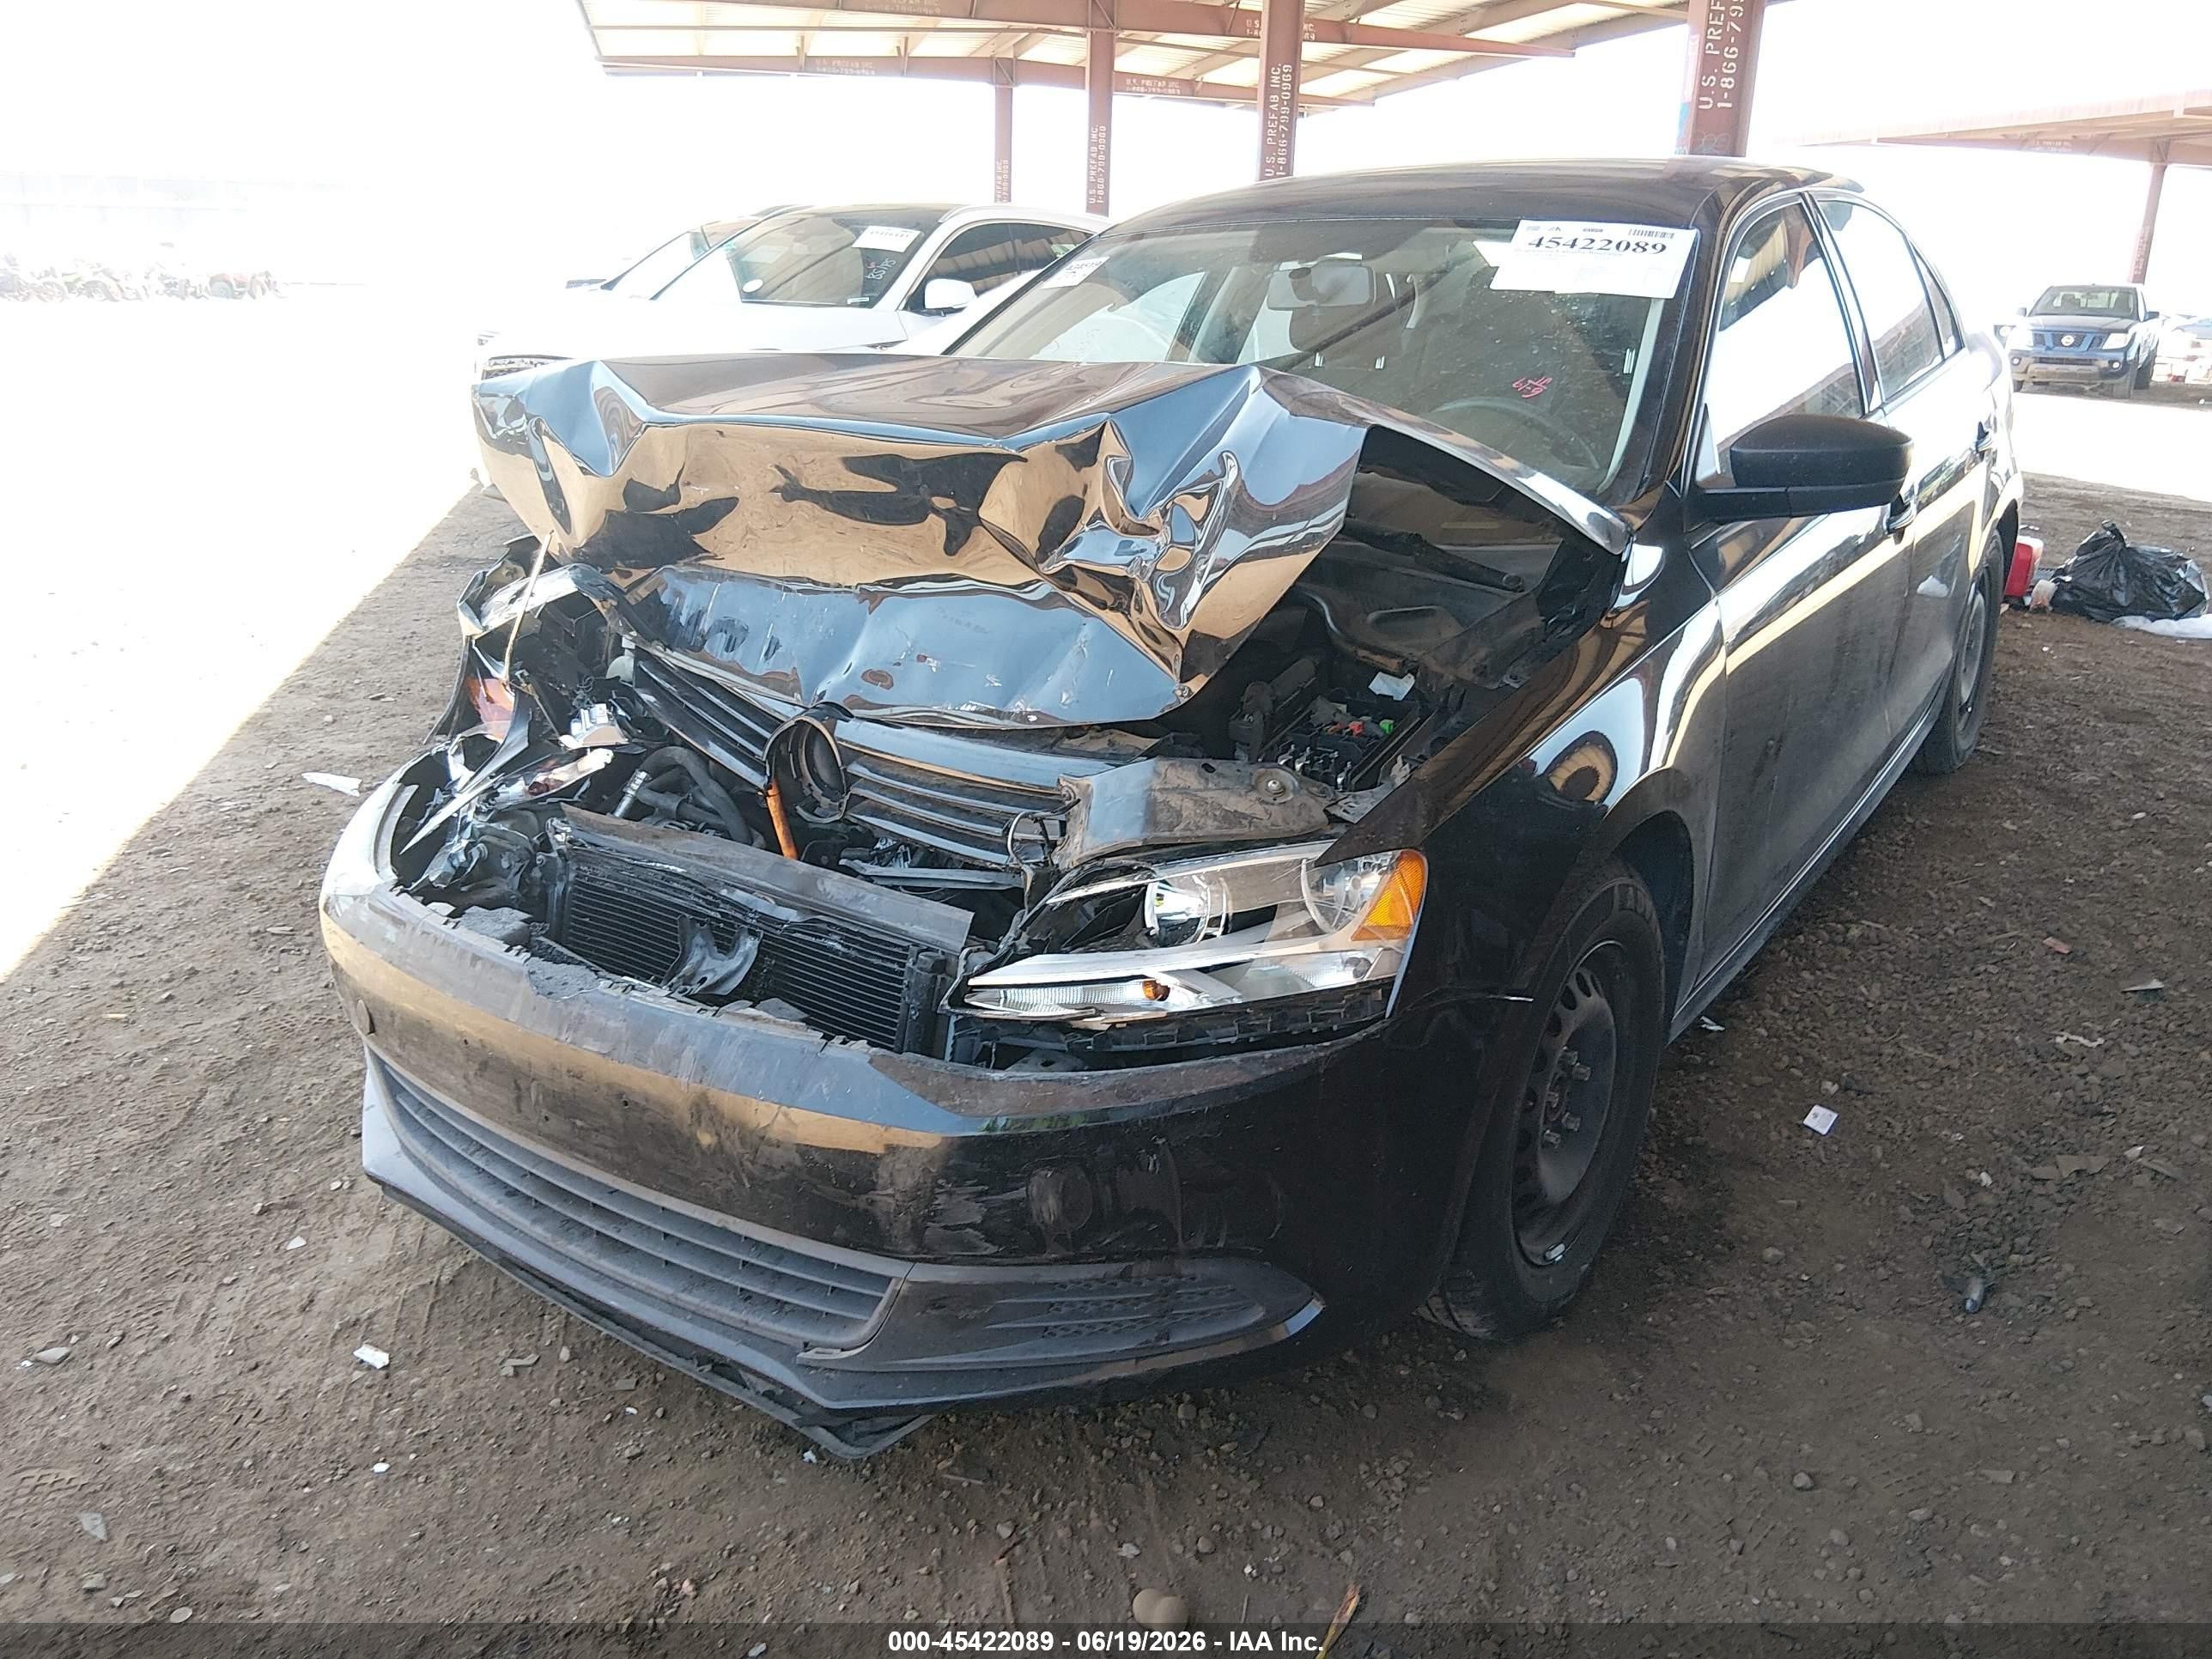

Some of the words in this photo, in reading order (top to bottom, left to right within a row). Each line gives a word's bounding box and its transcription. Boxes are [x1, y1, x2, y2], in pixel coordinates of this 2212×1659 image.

[1717, 0, 1745, 109] 1-866-79
[1270, 64, 1281, 88] INC.
[1698, 69, 1717, 110] U.S.
[1267, 94, 1279, 145] PREFAB
[1276, 64, 1292, 176] 1-866-799-0969
[1265, 153, 1276, 176] U.S.
[1528, 236, 1668, 254] 45422089
